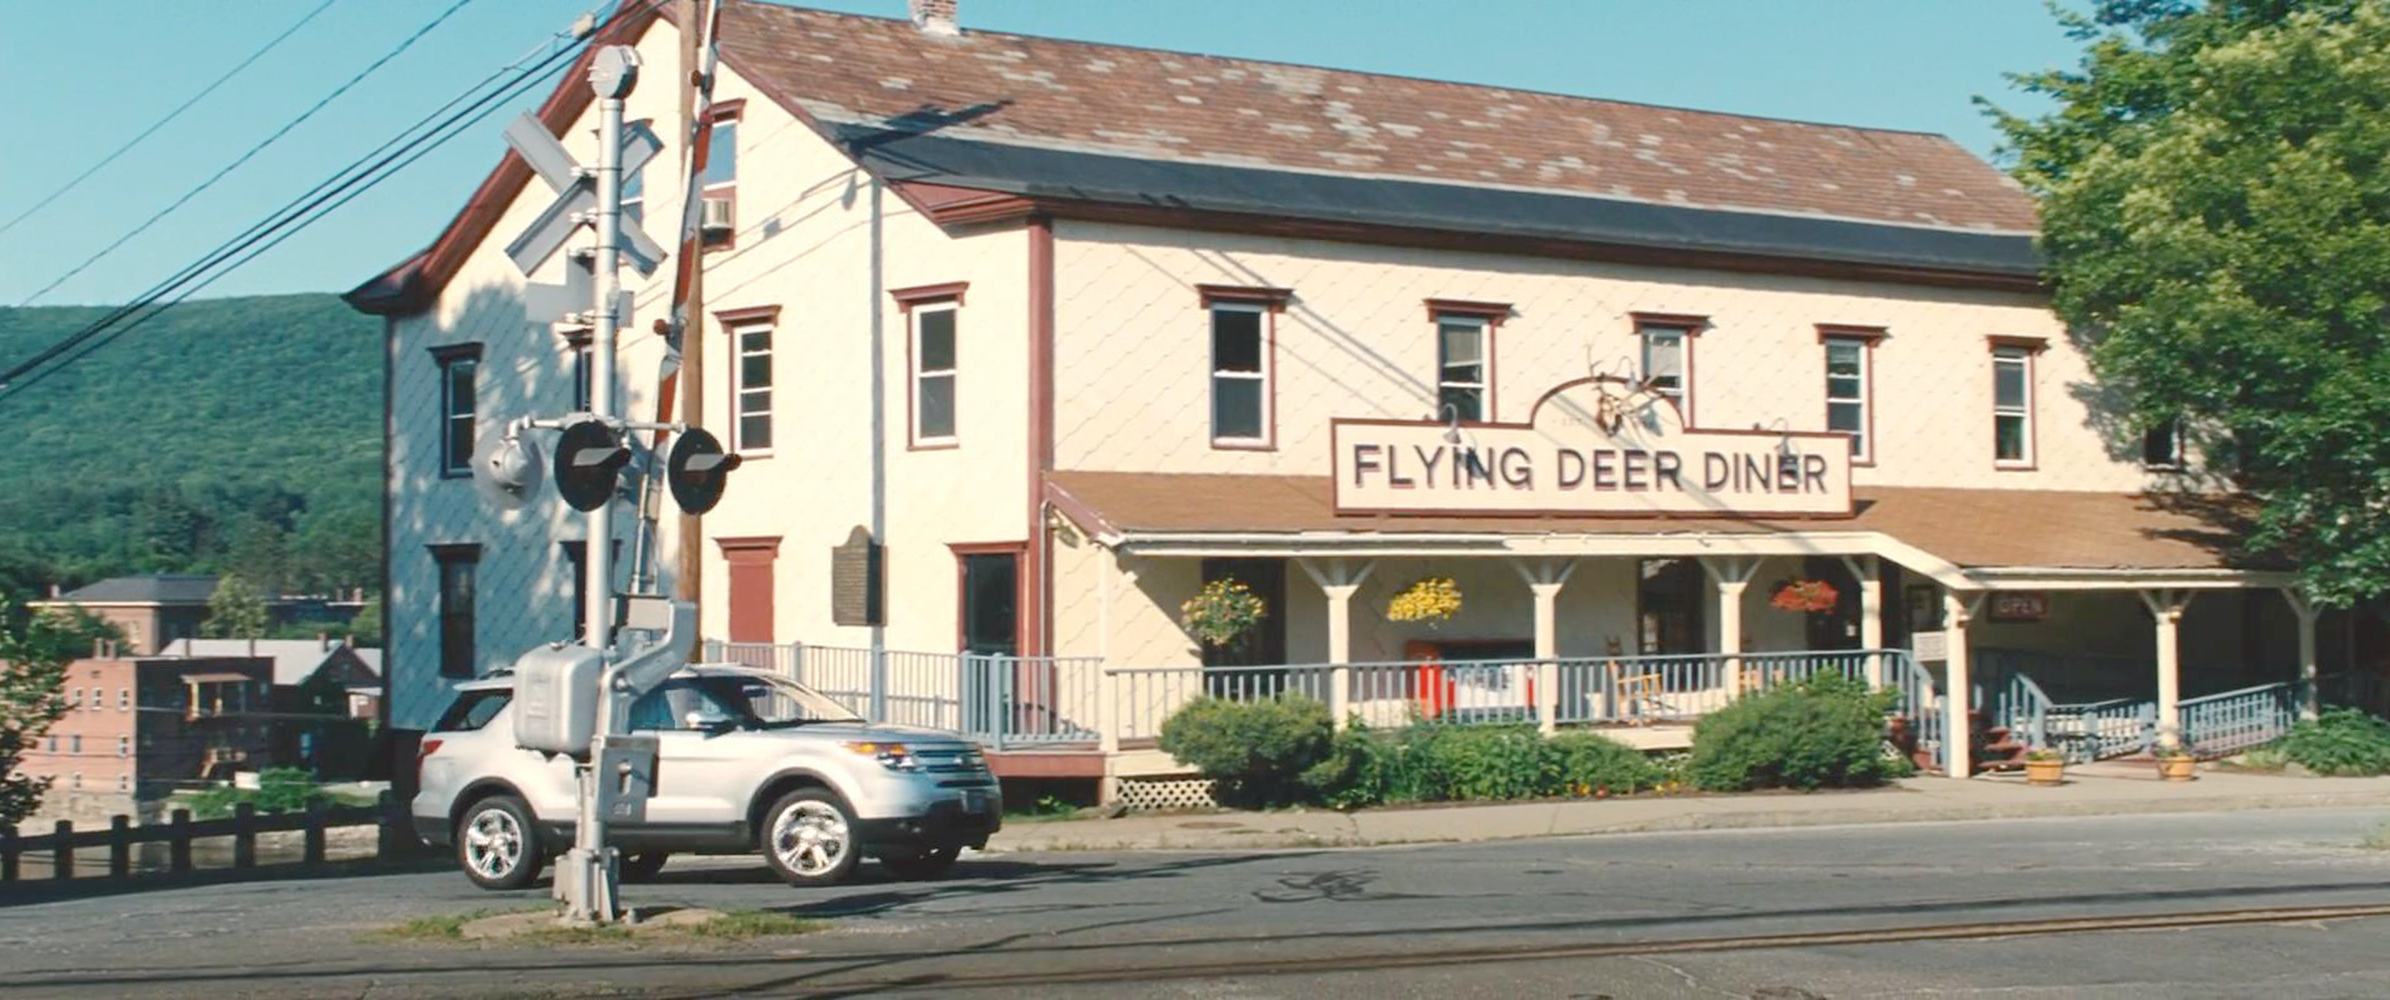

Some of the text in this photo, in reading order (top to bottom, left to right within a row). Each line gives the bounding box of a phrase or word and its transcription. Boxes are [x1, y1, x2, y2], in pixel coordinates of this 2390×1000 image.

[1354, 443, 1827, 494] FLYING DEER DINER
[1998, 598, 2043, 613] OPEN
